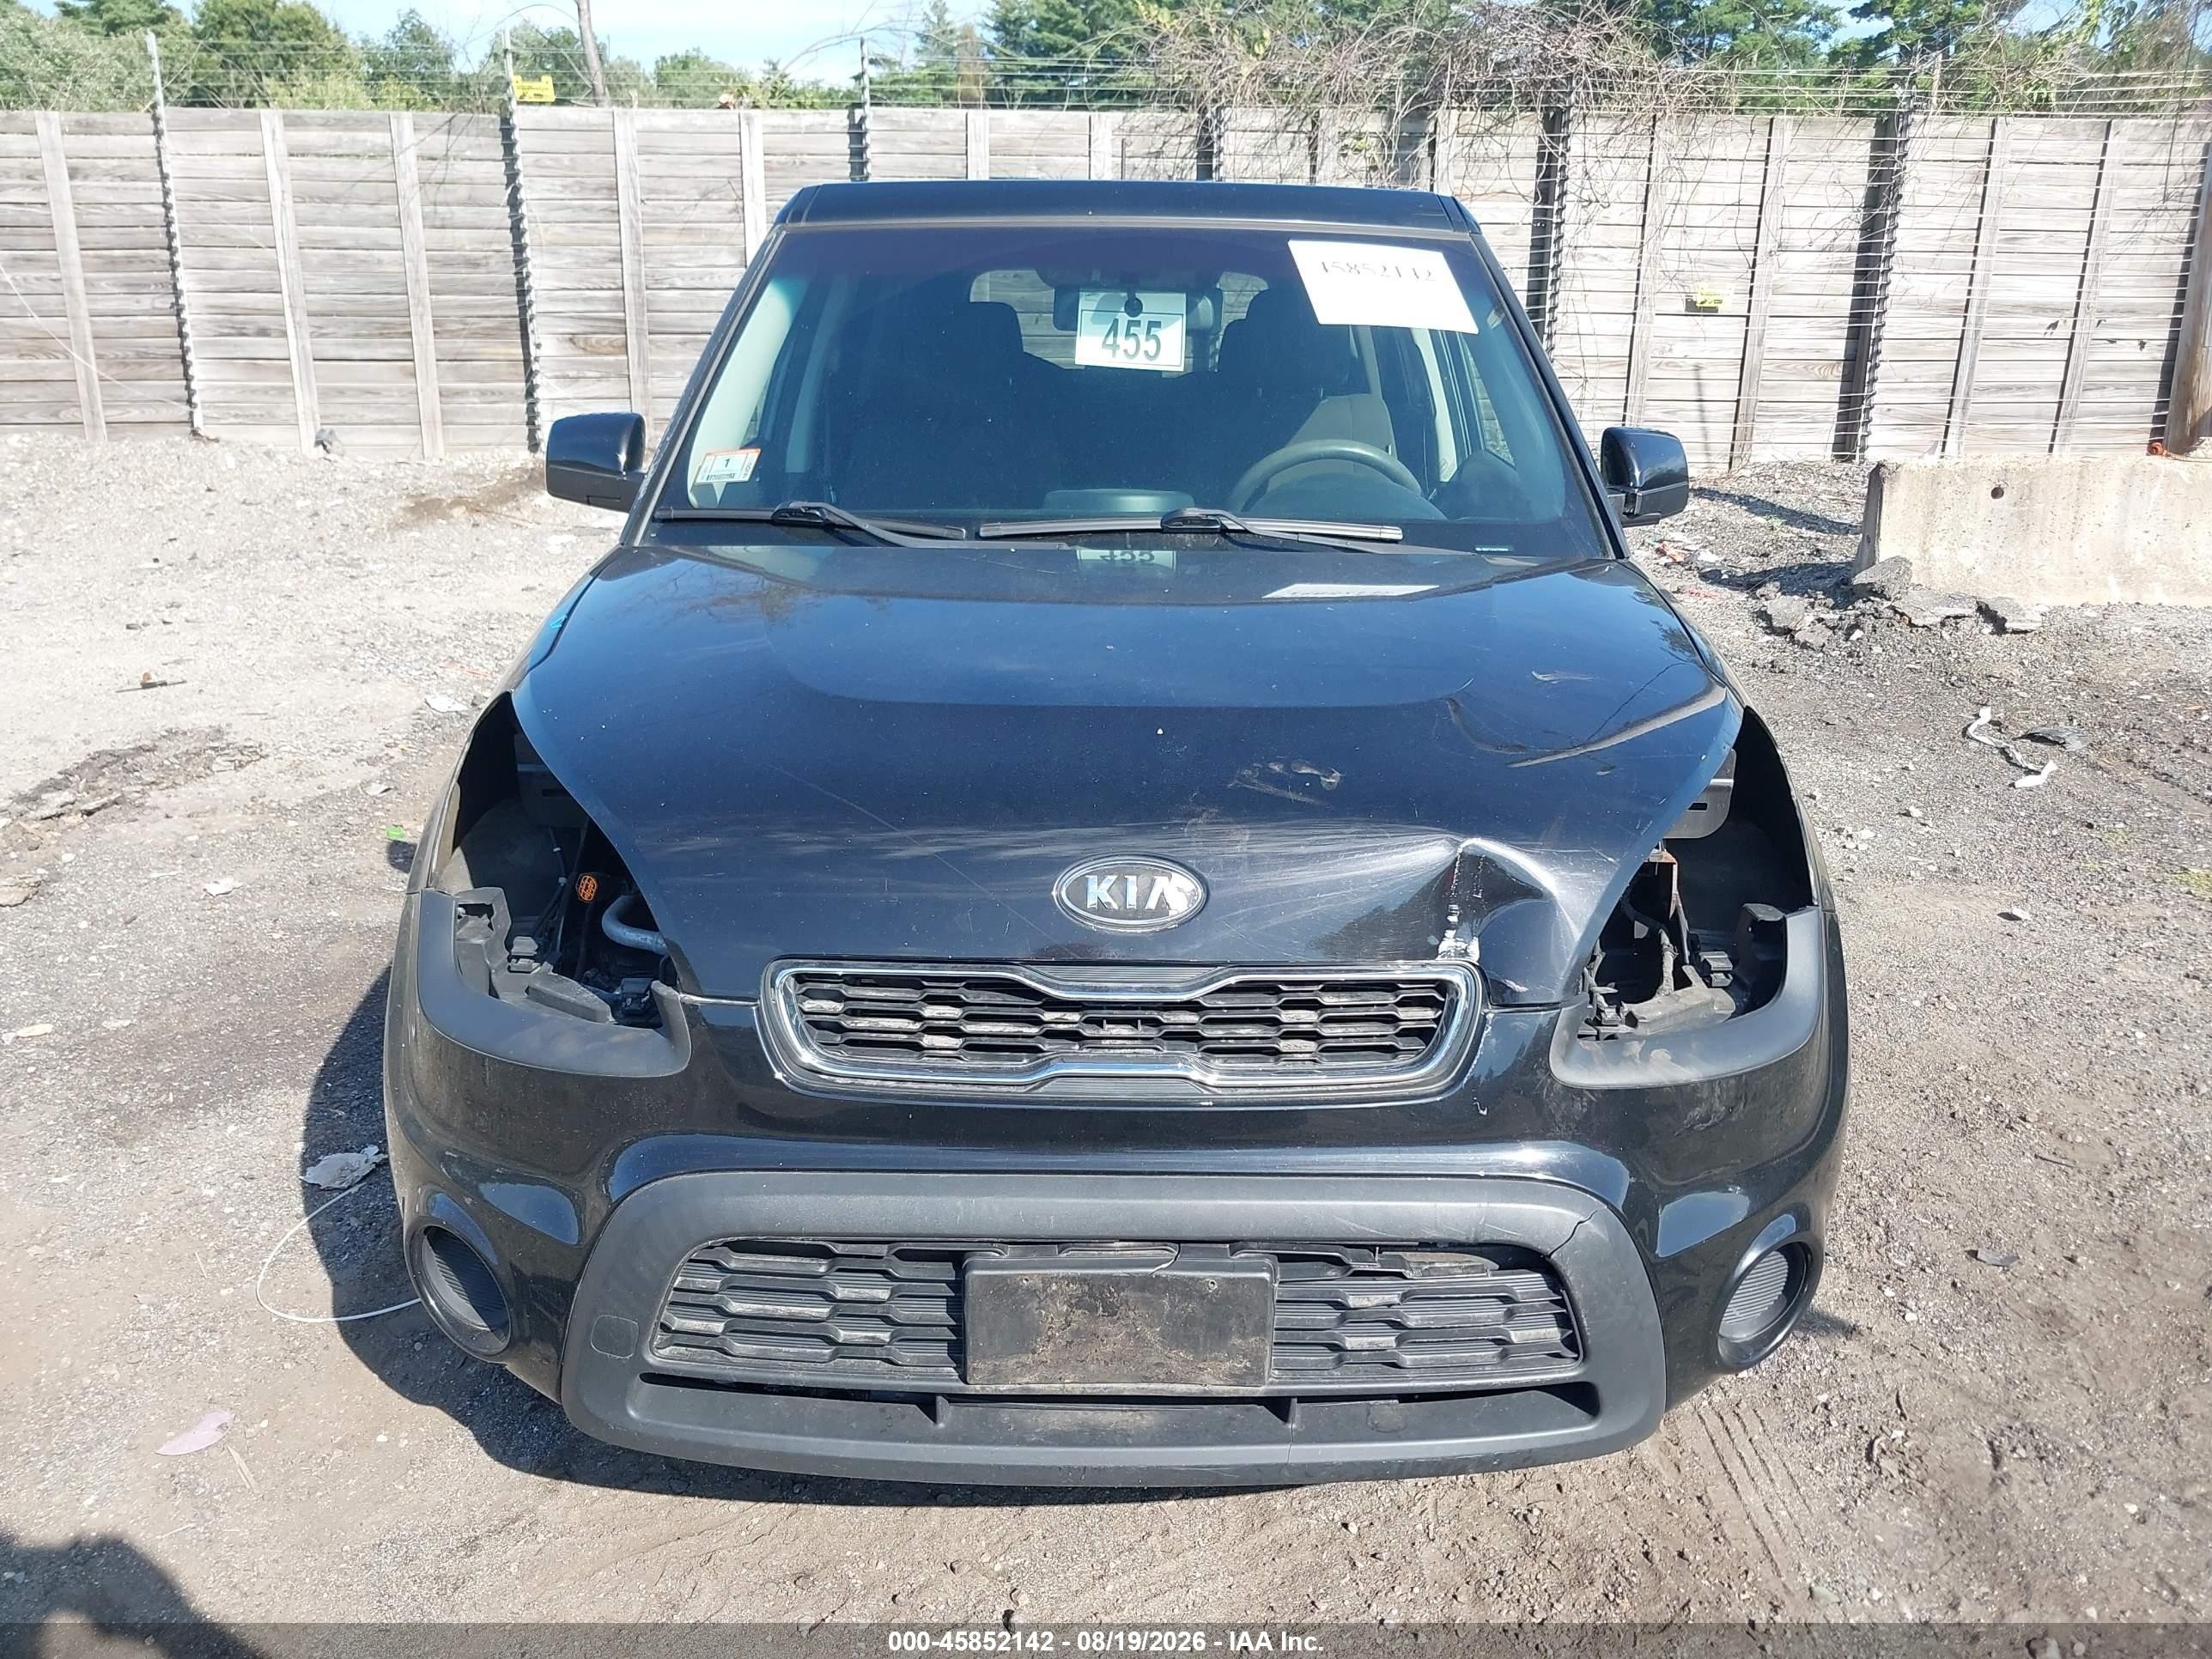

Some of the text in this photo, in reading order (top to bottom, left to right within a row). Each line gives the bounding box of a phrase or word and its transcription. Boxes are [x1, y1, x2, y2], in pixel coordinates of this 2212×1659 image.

[1102, 317, 1162, 362] 455
[724, 457, 732, 469] 1
[1085, 874, 1182, 911] KIA
